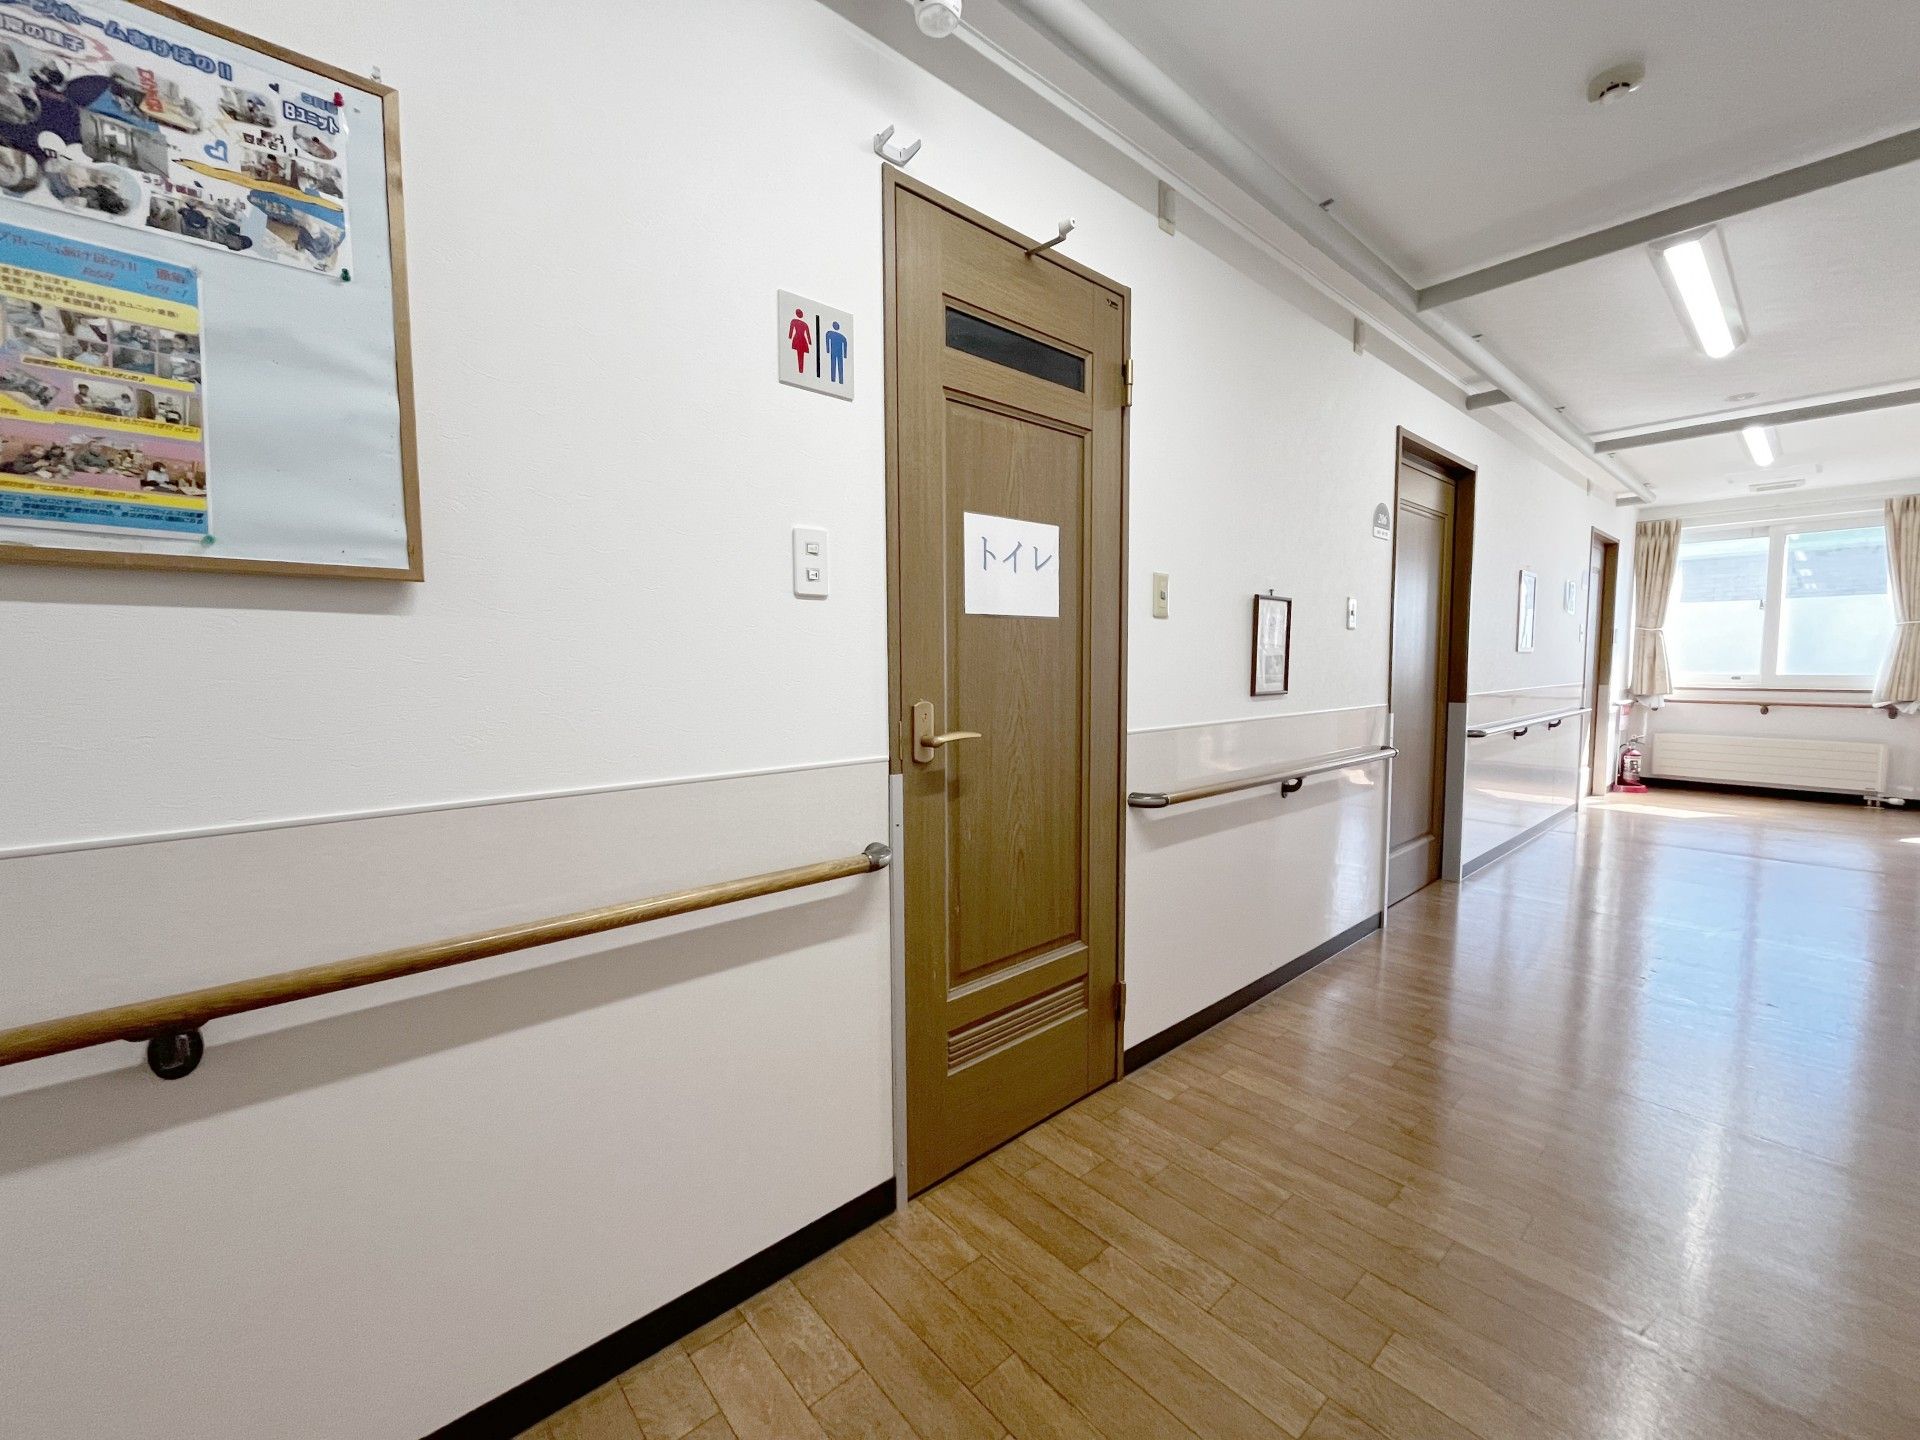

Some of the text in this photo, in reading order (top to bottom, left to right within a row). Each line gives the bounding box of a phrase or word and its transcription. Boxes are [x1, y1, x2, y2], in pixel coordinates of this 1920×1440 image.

[283, 101, 339, 135] Bユニット
[981, 536, 1052, 573] トイレ
